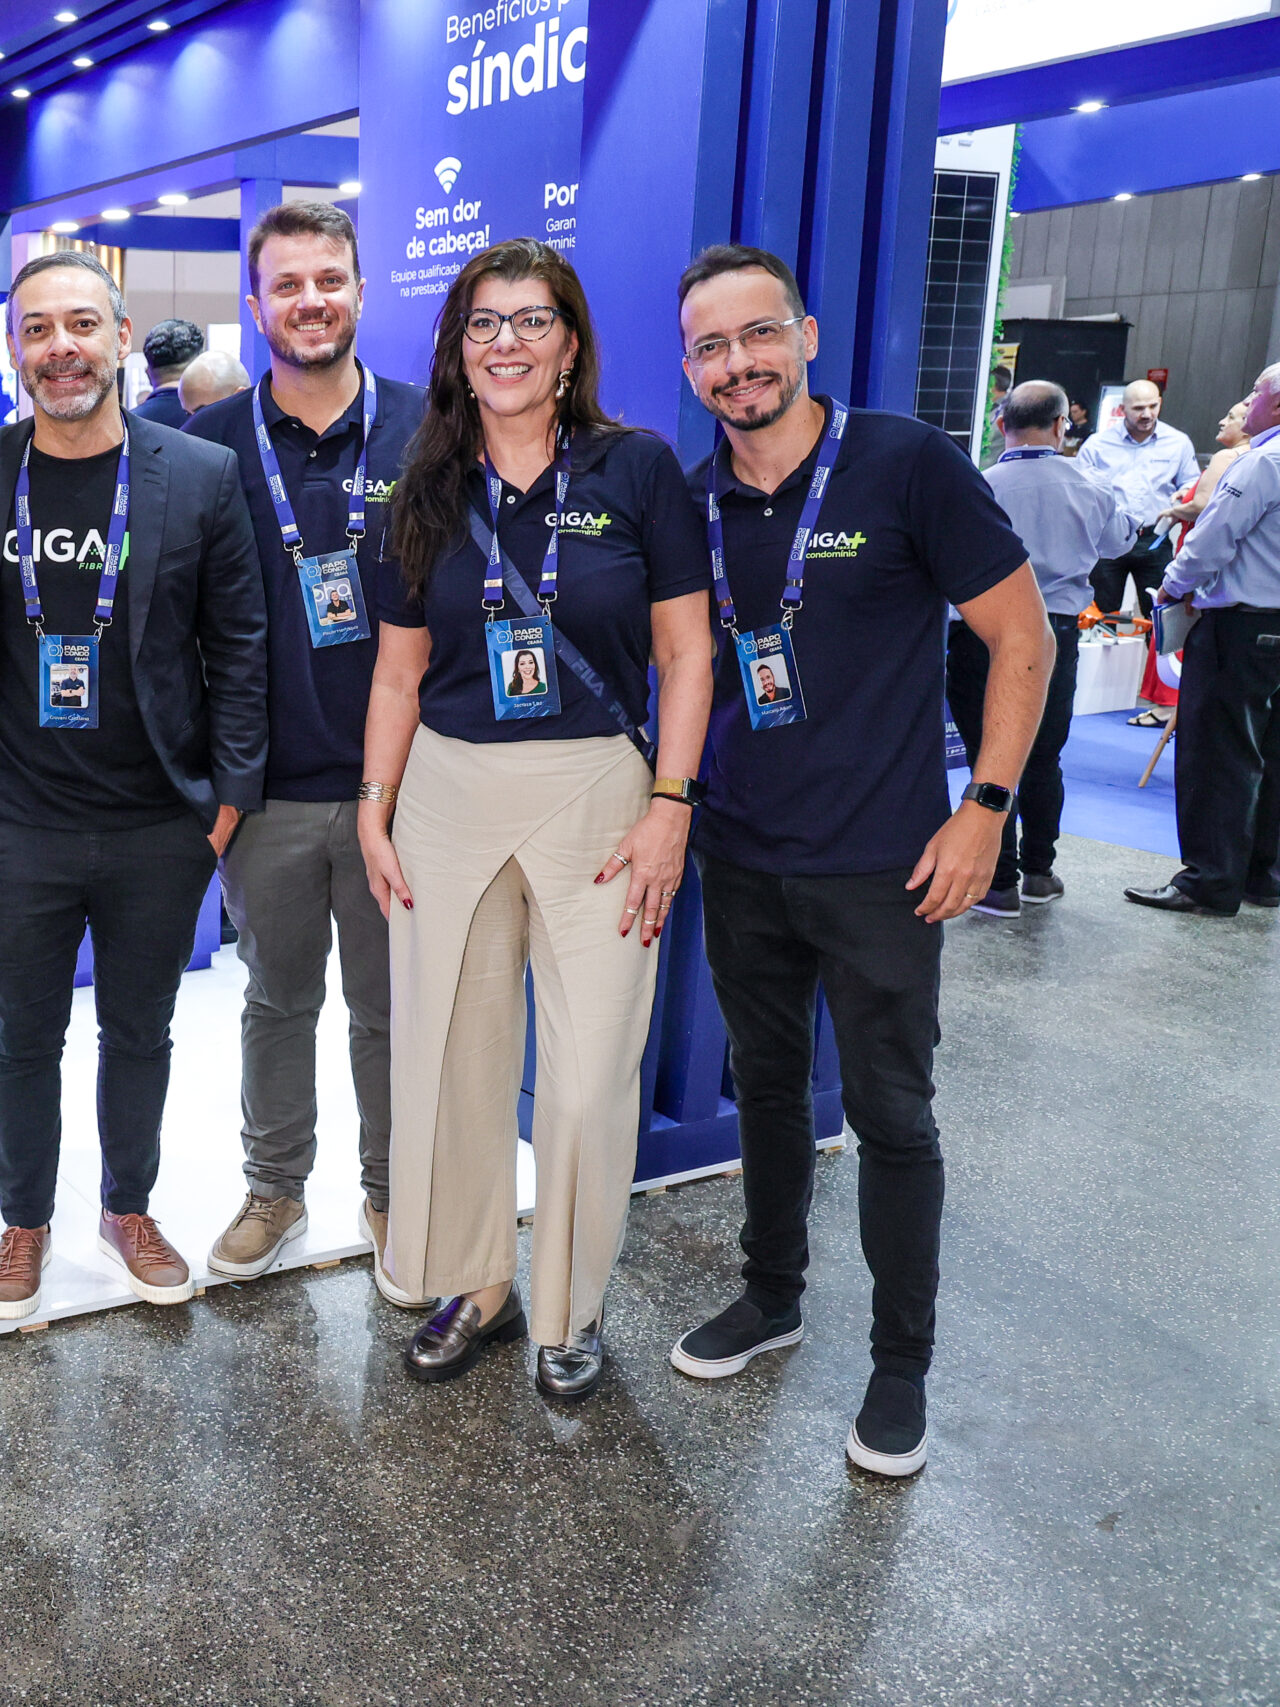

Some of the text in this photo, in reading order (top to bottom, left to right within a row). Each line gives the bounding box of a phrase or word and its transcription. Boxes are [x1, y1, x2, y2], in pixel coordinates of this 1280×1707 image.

[415, 198, 481, 230] Sem dor
[406, 224, 490, 260] de cabeça!
[391, 270, 418, 283] Equipe
[418, 262, 461, 280] qualificada
[400, 281, 449, 298] na prestação
[812, 466, 821, 488] PAPO
[557, 527, 602, 536] ondomínio
[793, 527, 802, 549] PAPO
[806, 550, 857, 559] condomínio
[322, 560, 347, 570] PAPO
[322, 565, 348, 575] CONDO
[514, 627, 542, 636] PAPO
[757, 633, 781, 645] PAPO
[758, 640, 782, 650] CONDO
[570, 657, 605, 698] FILA
